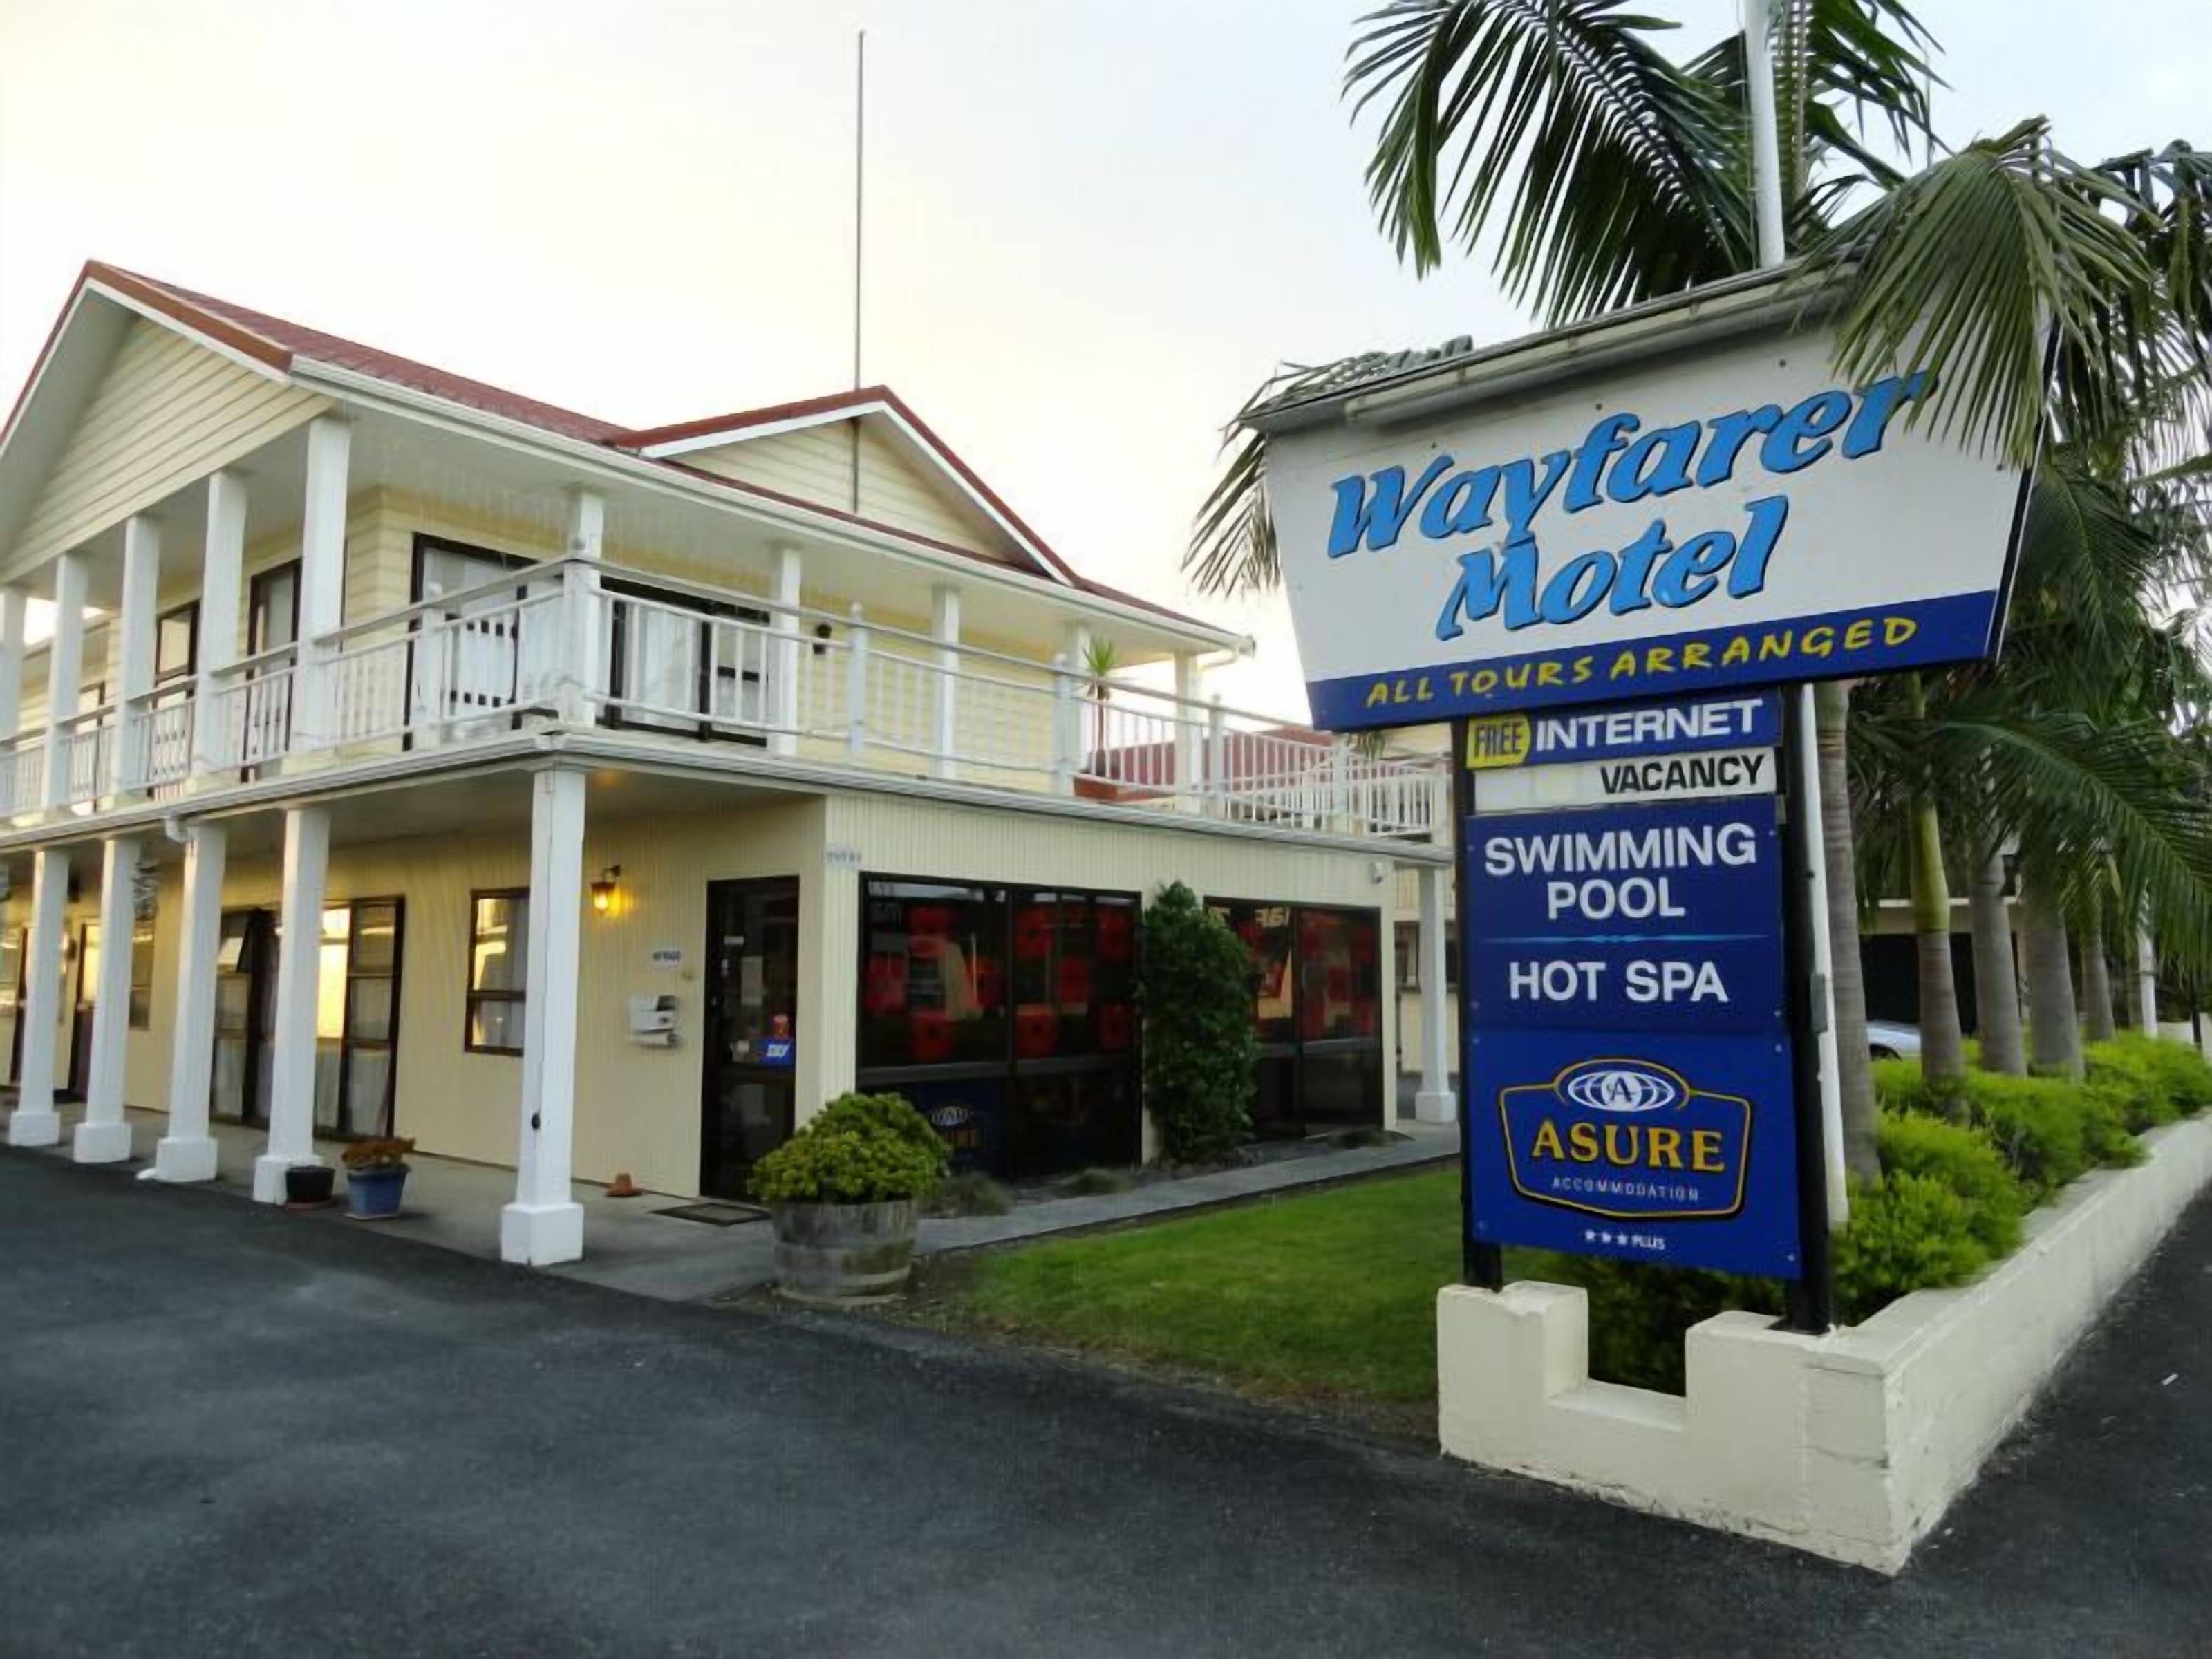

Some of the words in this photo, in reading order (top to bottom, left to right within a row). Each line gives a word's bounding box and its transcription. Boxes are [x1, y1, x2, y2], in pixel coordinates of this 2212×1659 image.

[1327, 369, 1940, 559] Wayfarer
[1434, 494, 1789, 641] Motel
[1367, 682, 1434, 708] ALL
[1450, 656, 1593, 699] TOURS
[1610, 616, 1920, 678] ARRANGED
[1473, 721, 1523, 757] FREE
[1536, 698, 1763, 752] INTERNET
[1601, 755, 1765, 794] VACANCY
[1485, 823, 1757, 877] SWIMMING
[1547, 877, 1685, 921] POOL
[1509, 961, 1606, 1001] HOT
[1625, 960, 1729, 1002] SPA
[1532, 1120, 1726, 1172] ASURE
[1552, 1177, 1699, 1202] ACCOMMODATION
